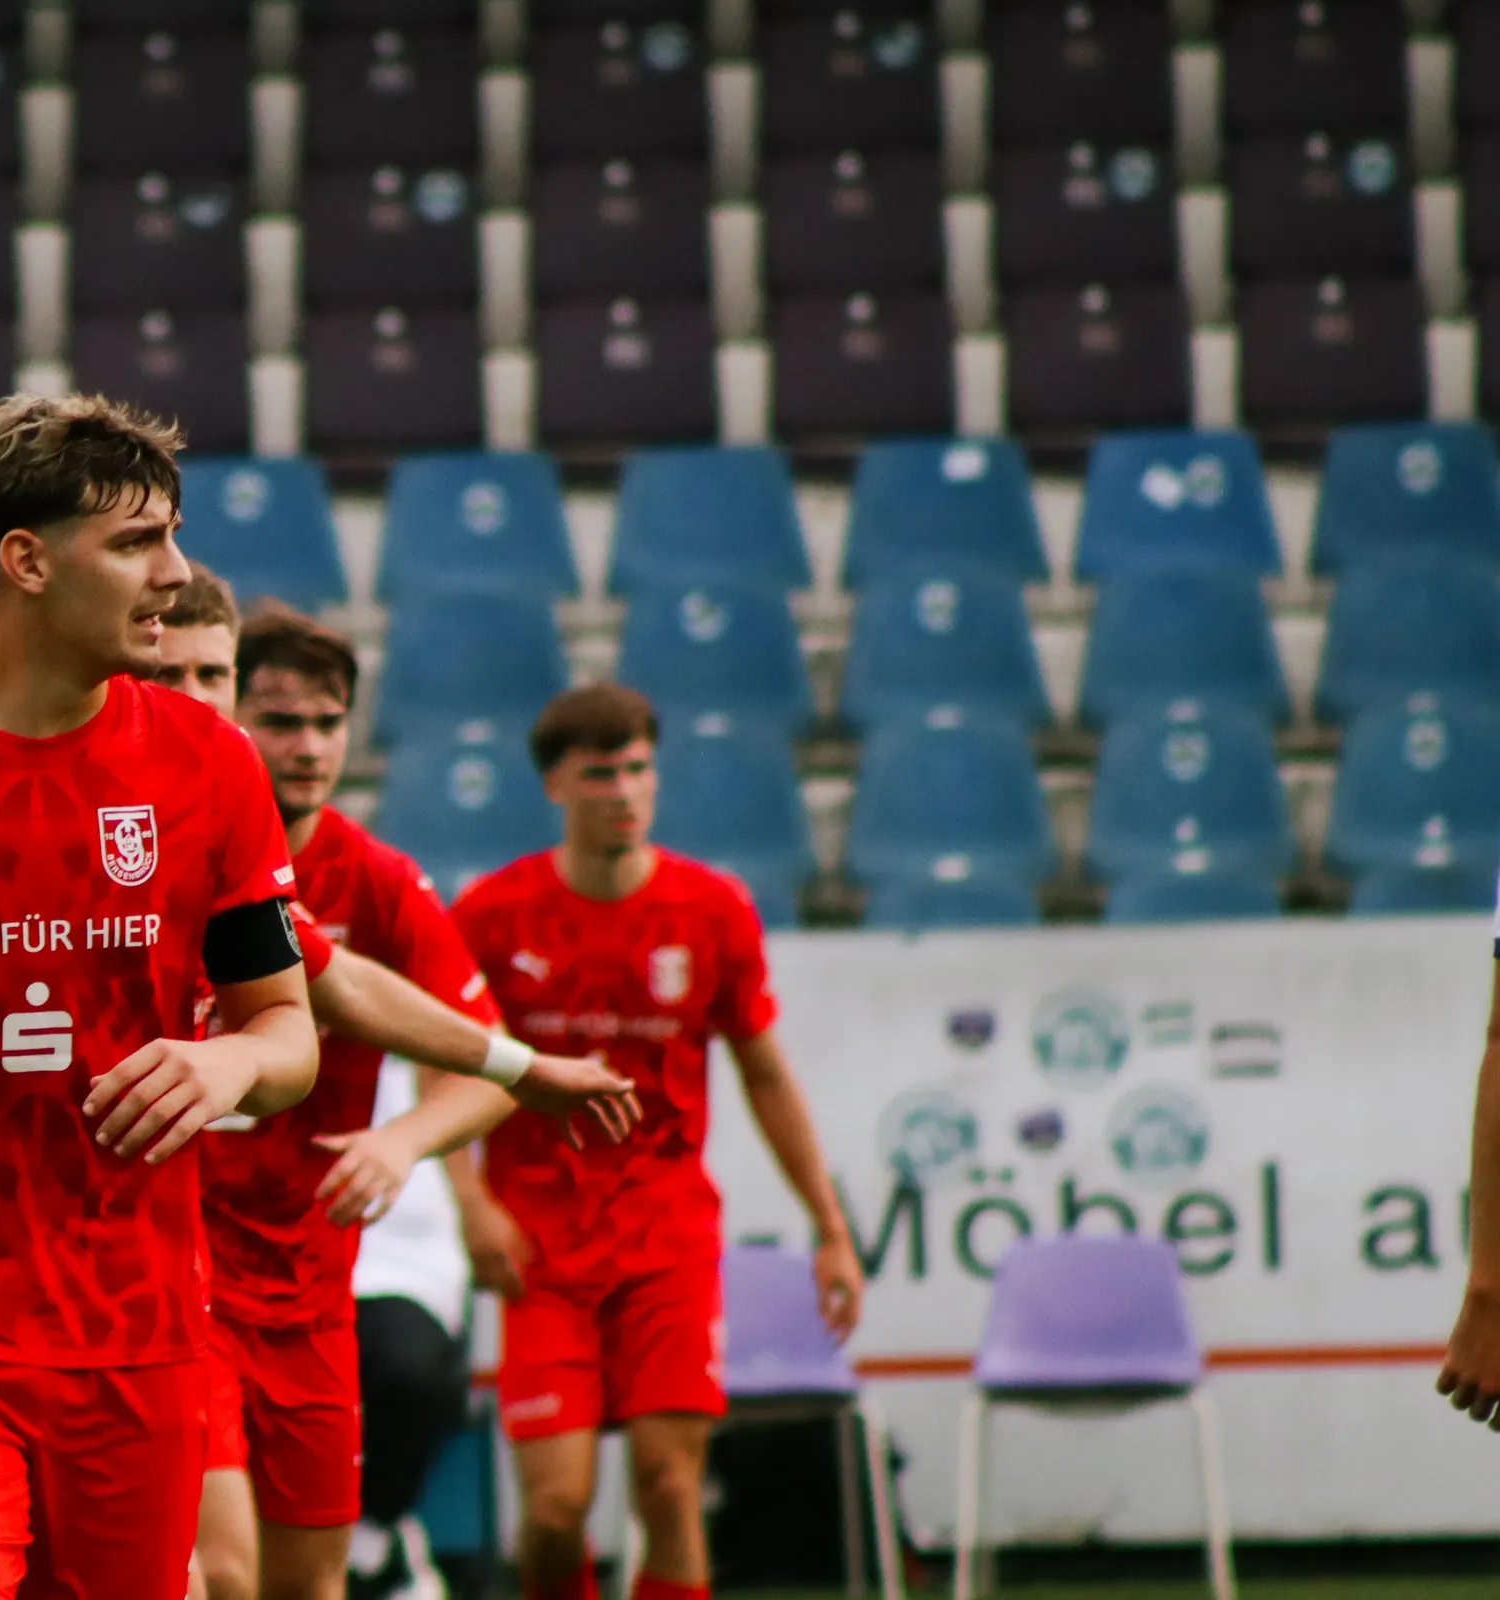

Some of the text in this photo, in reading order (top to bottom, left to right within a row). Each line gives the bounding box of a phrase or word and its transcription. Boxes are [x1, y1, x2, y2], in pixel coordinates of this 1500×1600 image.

[1, 914, 73, 954] FÜR
[87, 914, 161, 949] HIER
[1362, 1185, 1471, 1272] a
